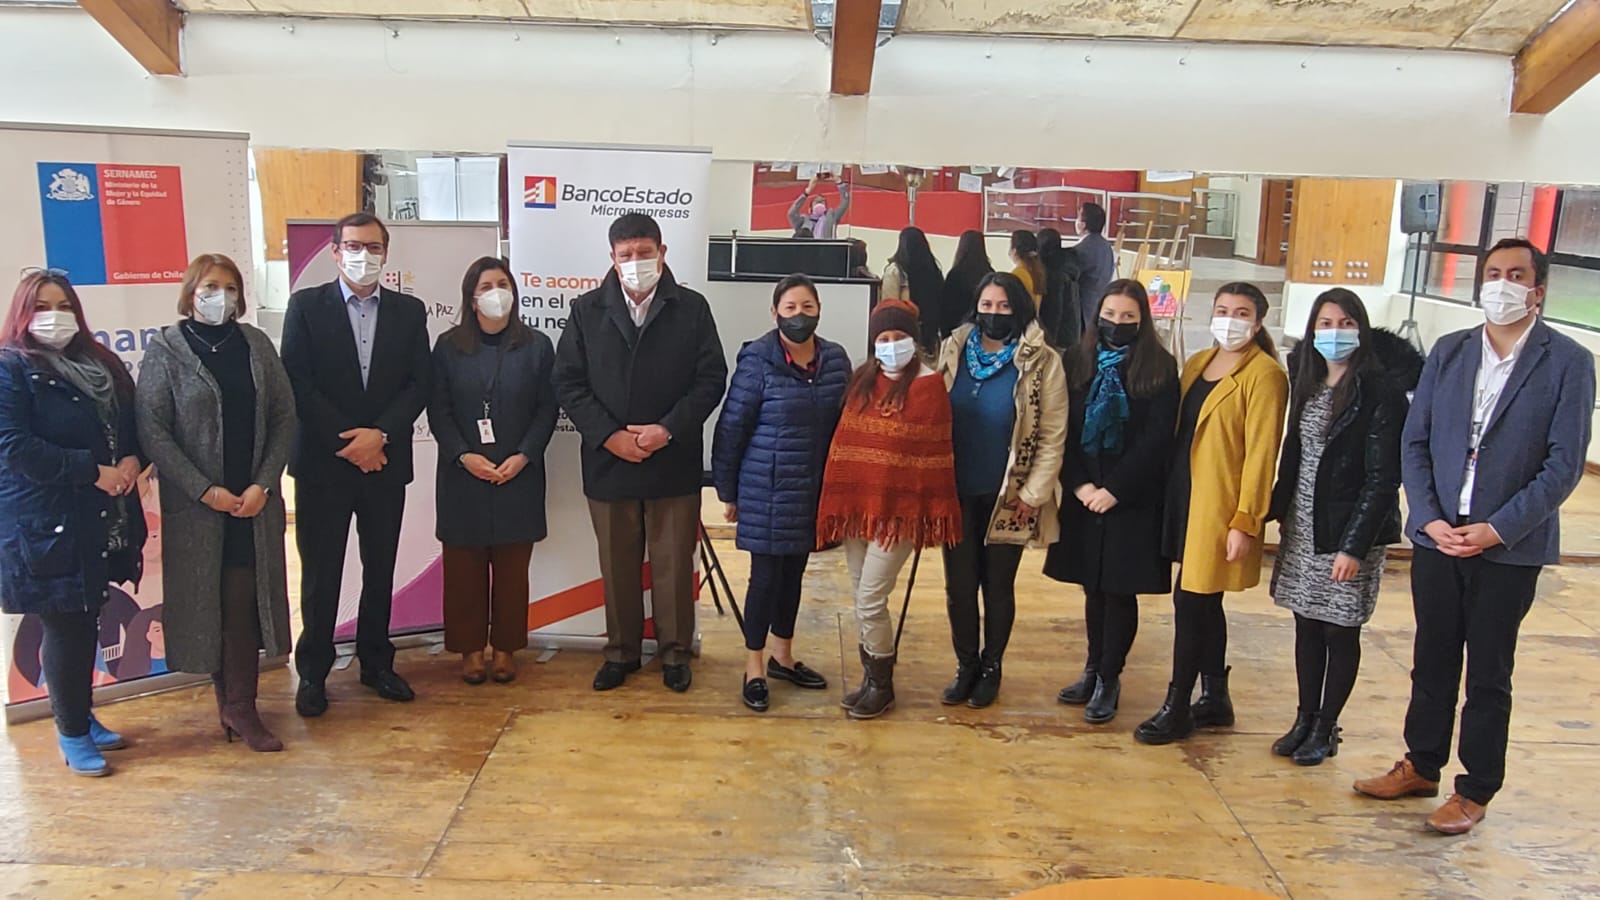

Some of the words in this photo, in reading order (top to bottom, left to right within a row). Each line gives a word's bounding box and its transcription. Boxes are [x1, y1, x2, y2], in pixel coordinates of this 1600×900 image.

[103, 169, 157, 179] SERNAMEG
[561, 183, 693, 206] BancoEstado
[112, 272, 150, 280] Gobierno
[151, 272, 162, 280] de
[520, 272, 542, 288] Te
[546, 276, 604, 289] acom
[521, 296, 543, 308] en
[548, 293, 564, 308] el
[435, 302, 454, 318] PAZ
[520, 314, 540, 328] tu
[544, 317, 567, 330] ne
